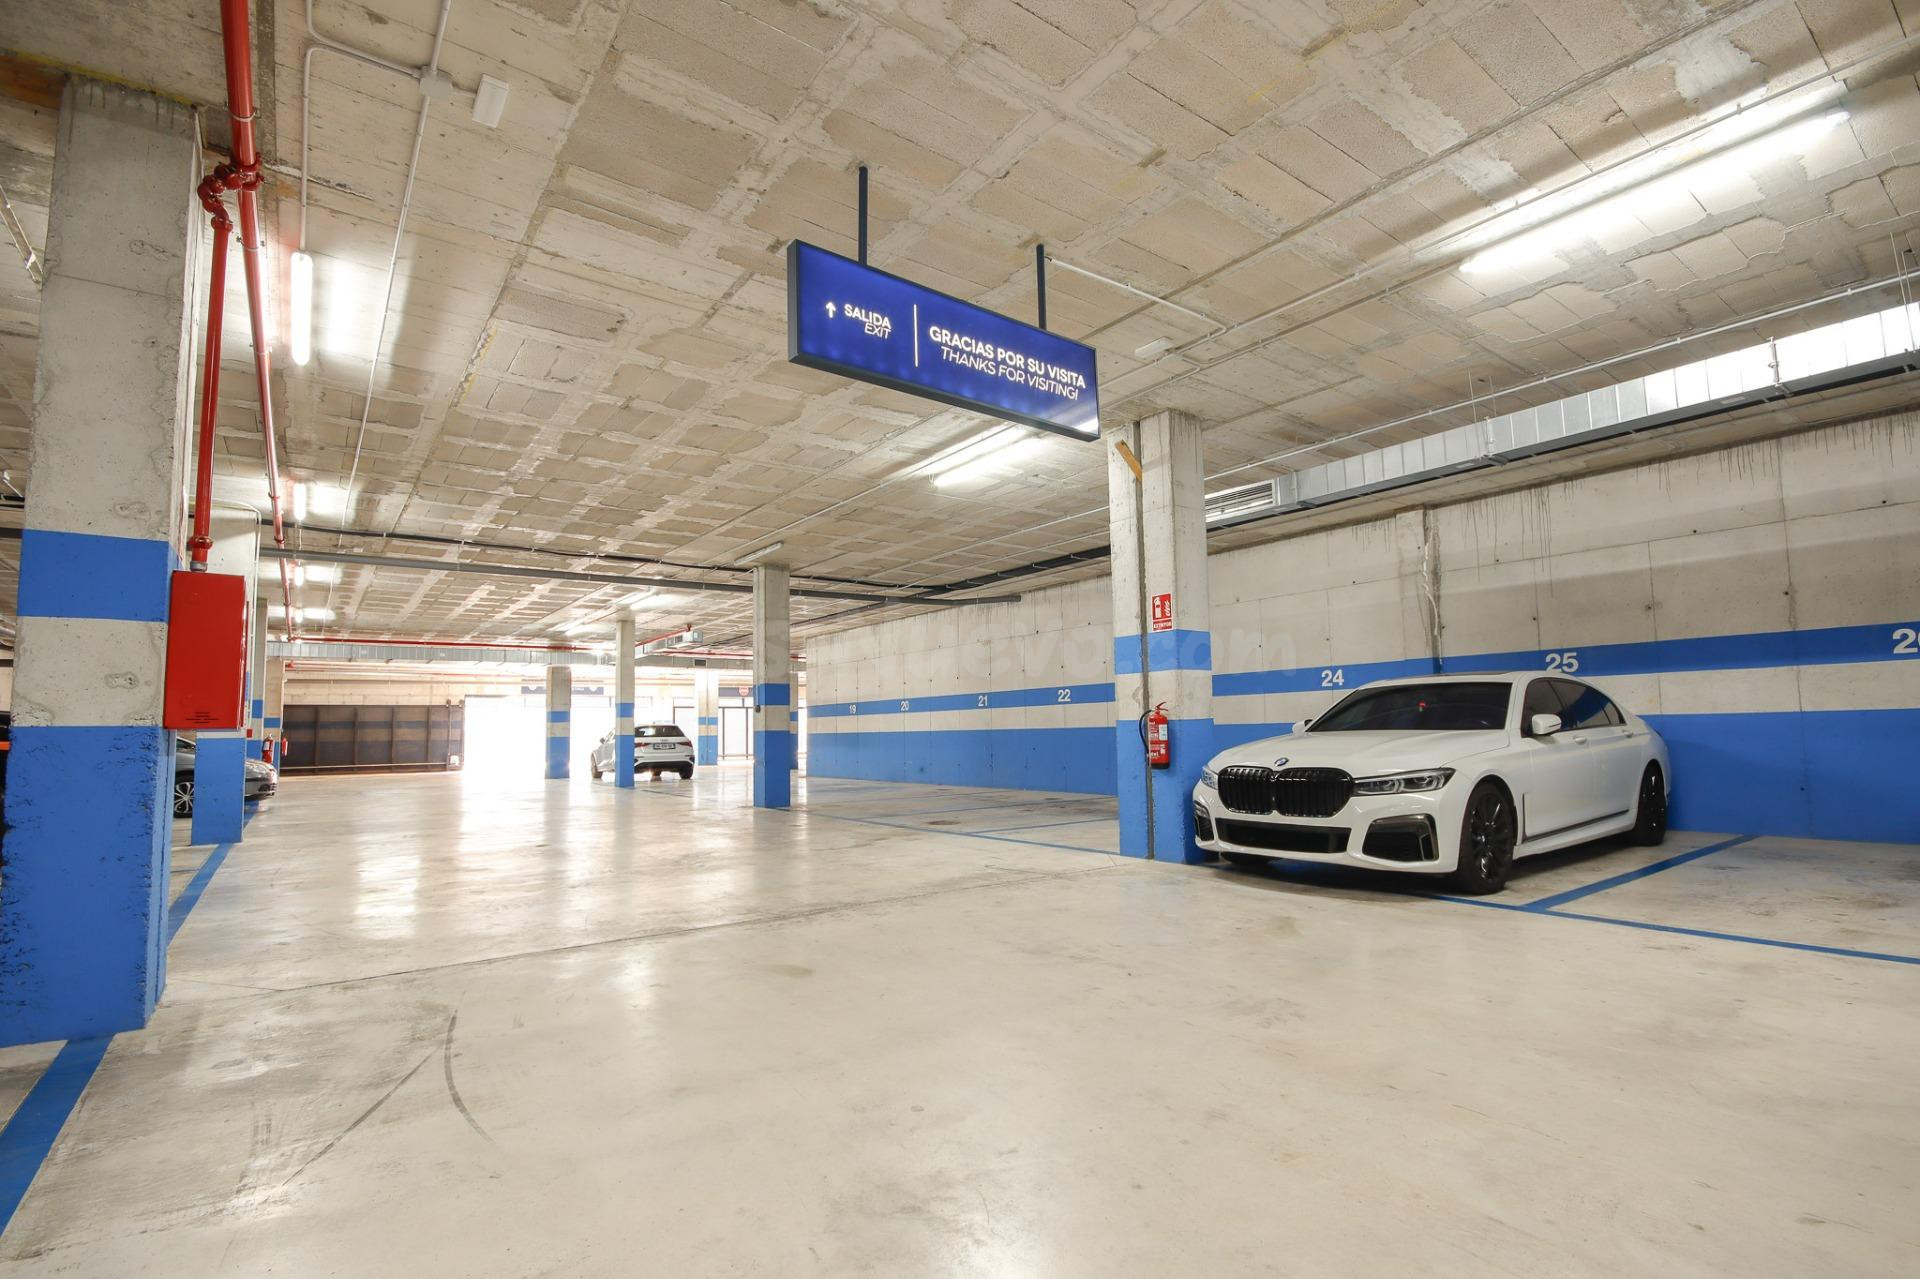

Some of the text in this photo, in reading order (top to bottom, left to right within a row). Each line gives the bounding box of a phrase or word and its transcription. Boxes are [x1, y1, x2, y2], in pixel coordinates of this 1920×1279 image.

[844, 303, 892, 329] SALIDA
[864, 322, 892, 339] EXIT
[929, 325, 1086, 389] GRACIAS POR SU VISITA
[941, 345, 997, 375] THANKS
[998, 364, 1026, 384] FOR
[1892, 628, 1920, 654] 2
[1545, 652, 1579, 672] 25
[1321, 669, 1345, 687] 24
[978, 695, 988, 707] 21
[1058, 689, 1071, 702] 22
[849, 705, 857, 714] 19
[901, 701, 910, 711] 20
